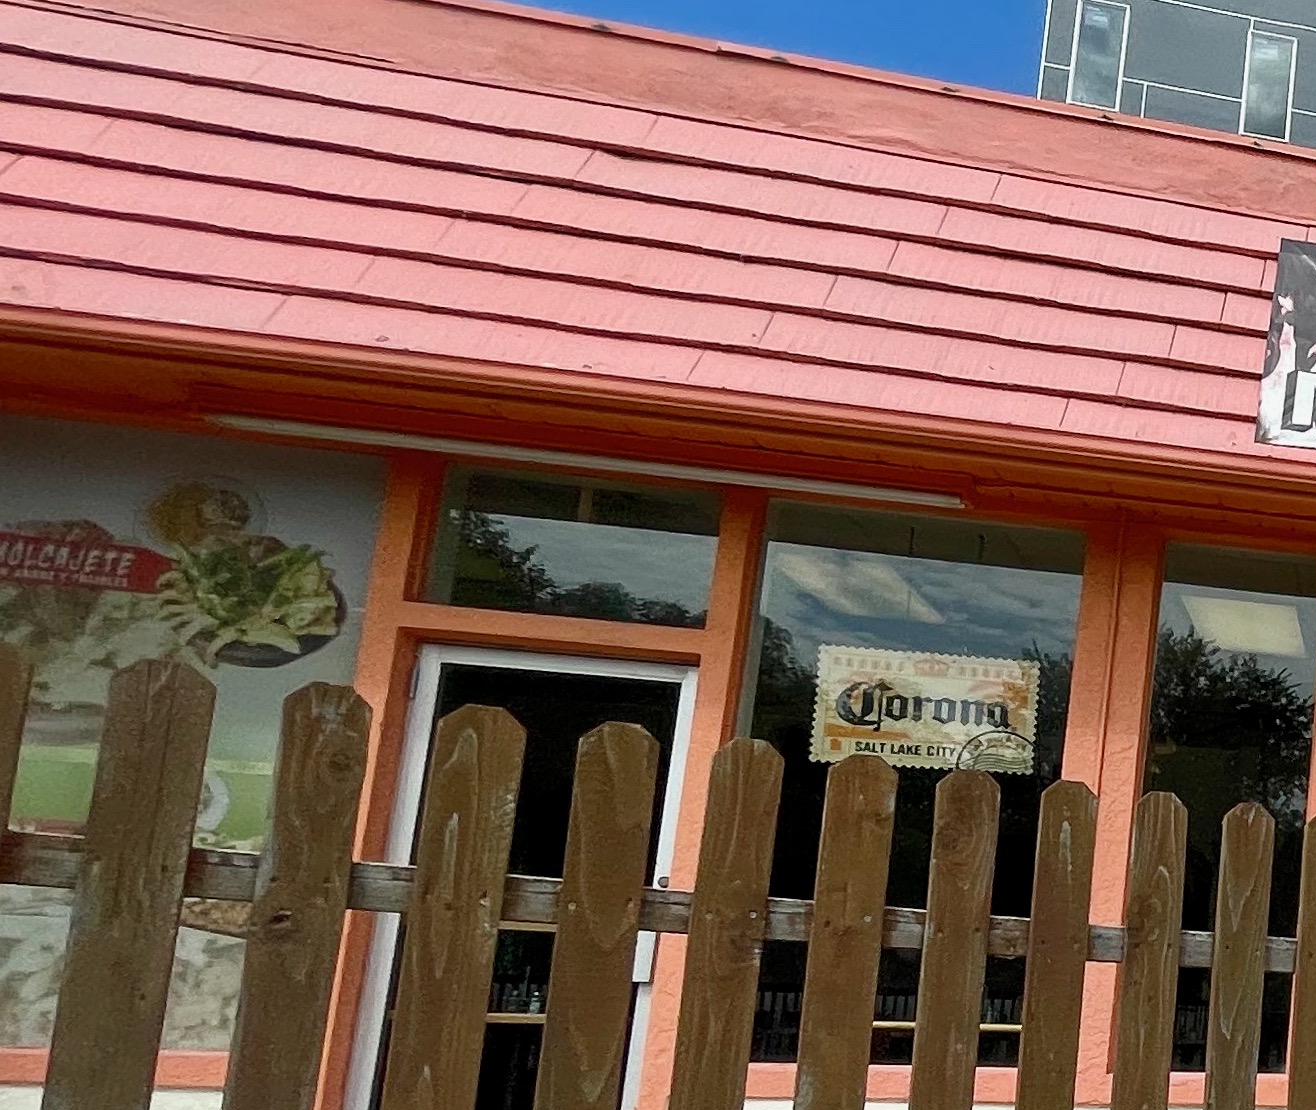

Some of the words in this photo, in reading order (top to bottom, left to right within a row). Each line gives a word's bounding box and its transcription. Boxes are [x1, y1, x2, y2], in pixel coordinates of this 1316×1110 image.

[836, 679, 1014, 732] Corona
[854, 741, 885, 754] SALT
[890, 744, 922, 756] LAKE
[926, 745, 957, 758] CITY
